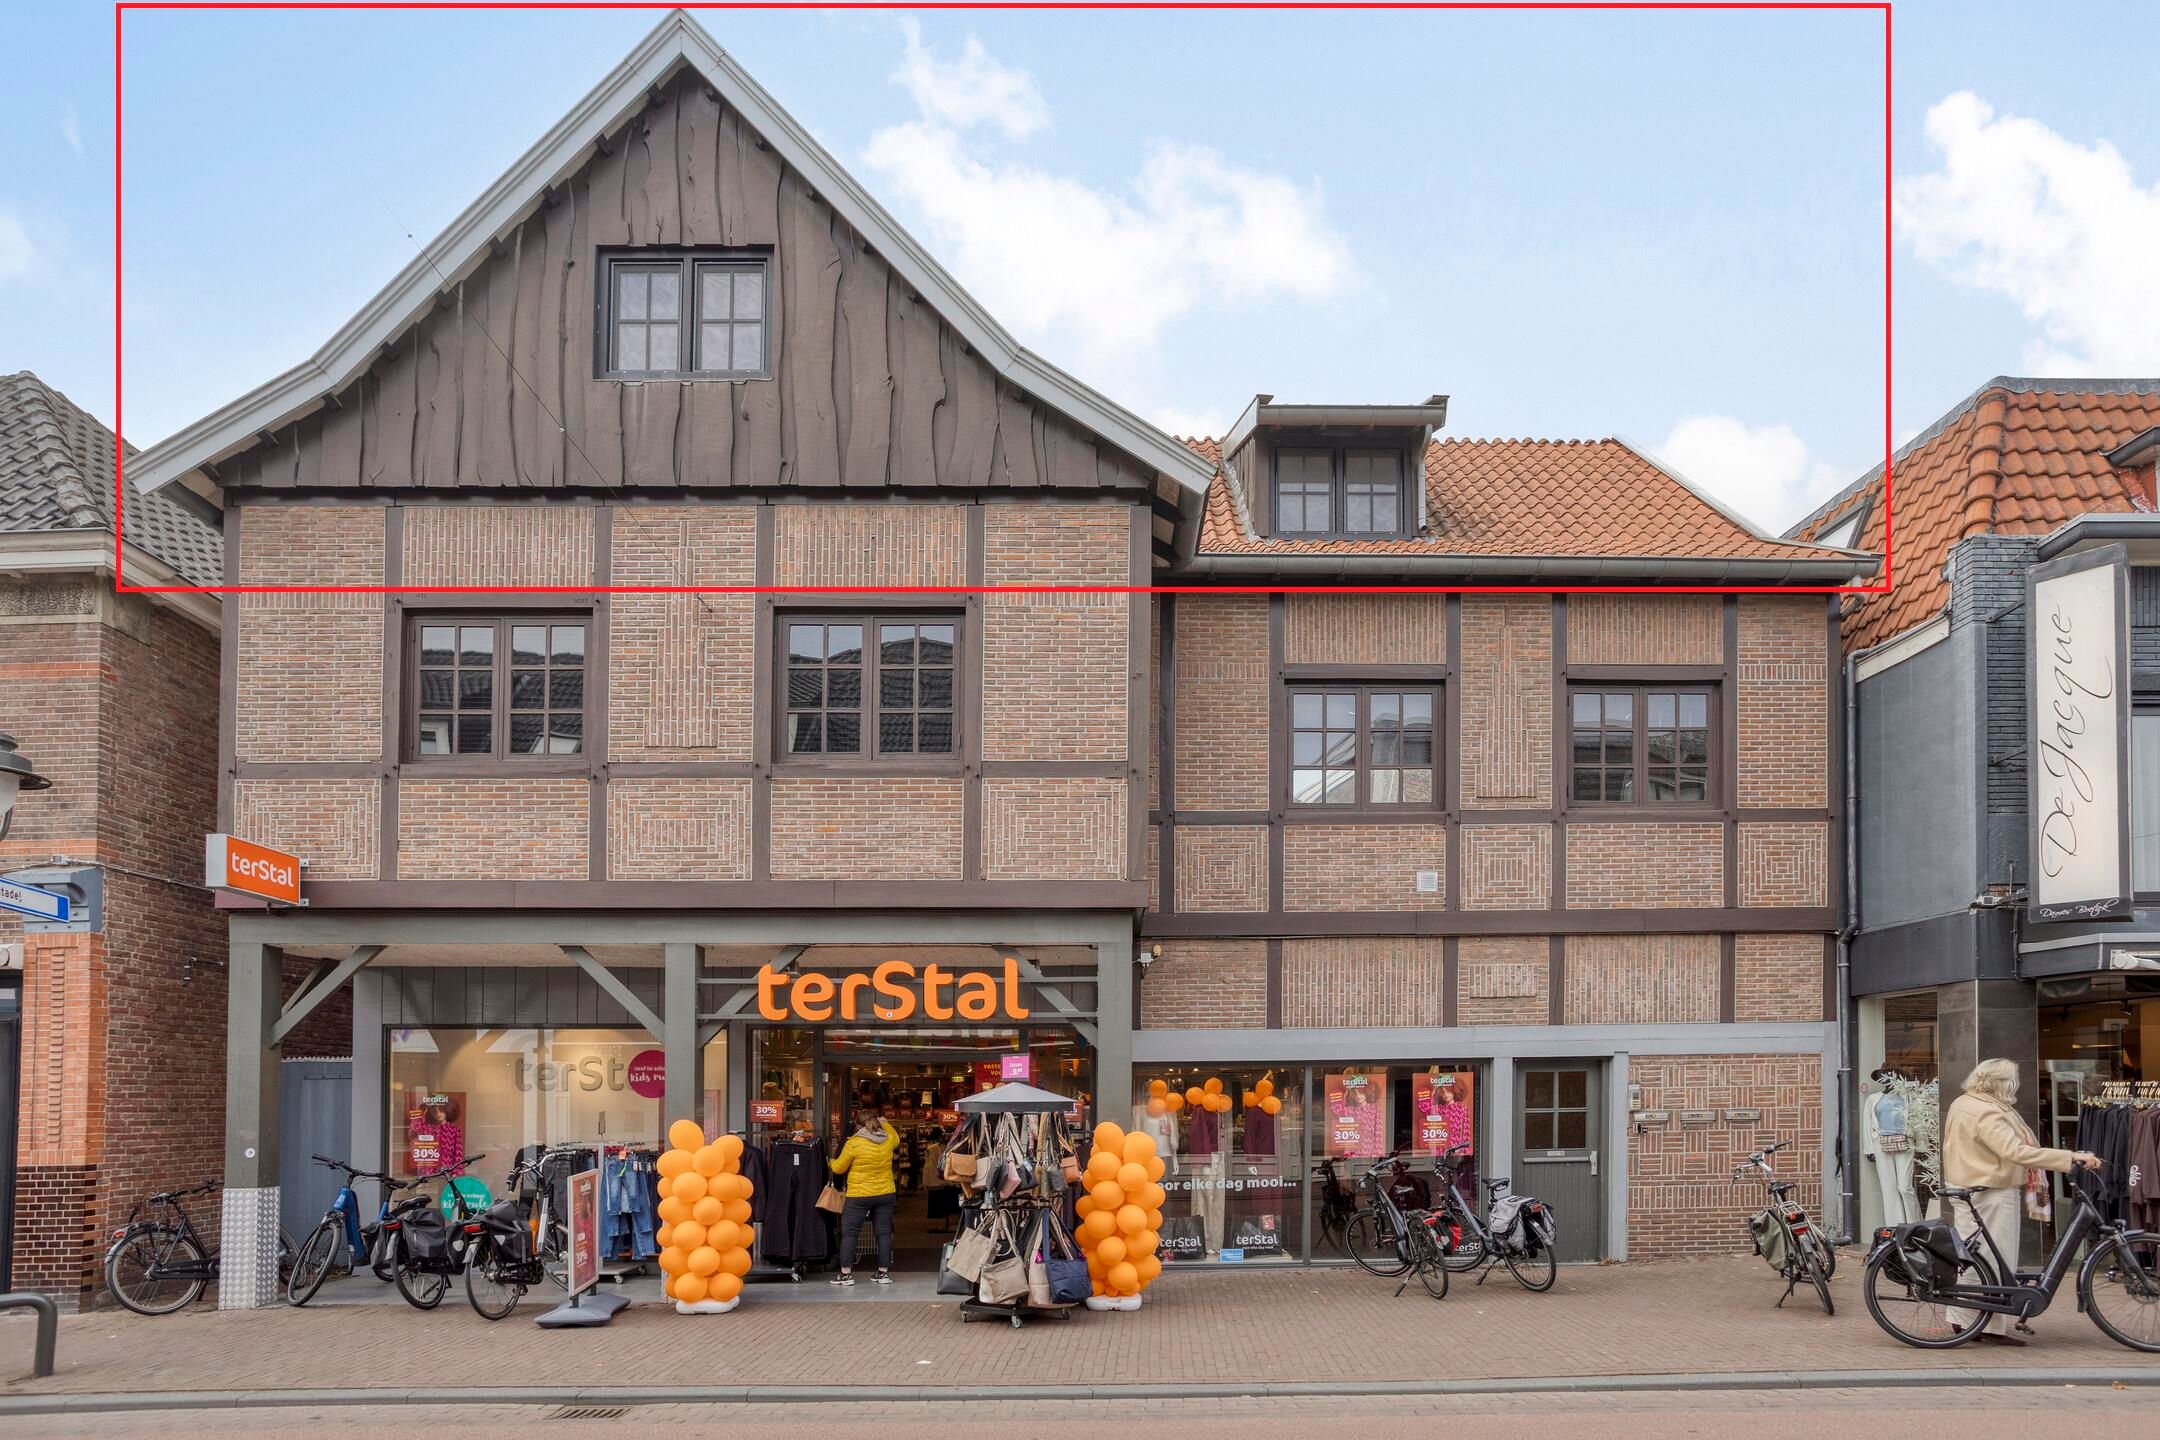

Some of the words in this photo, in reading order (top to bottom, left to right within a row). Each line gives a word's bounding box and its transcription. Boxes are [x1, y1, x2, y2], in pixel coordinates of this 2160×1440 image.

[231, 851, 294, 888] terStal
[757, 958, 1030, 1021] terStal
[514, 1055, 625, 1092] terSt
[630, 1071, 650, 1083] kids
[653, 1073, 665, 1081] ru
[756, 1106, 777, 1114] 30%
[1334, 1130, 1360, 1140] 30%
[1422, 1129, 1448, 1138] 30%
[413, 1148, 440, 1159] 30%
[1158, 1181, 1180, 1191] oor
[1183, 1177, 1214, 1191] elke
[1216, 1177, 1244, 1192] dag
[1159, 1235, 1202, 1248] terStal
[1235, 1233, 1279, 1246] terStal
[1456, 1241, 1480, 1251] terSt
